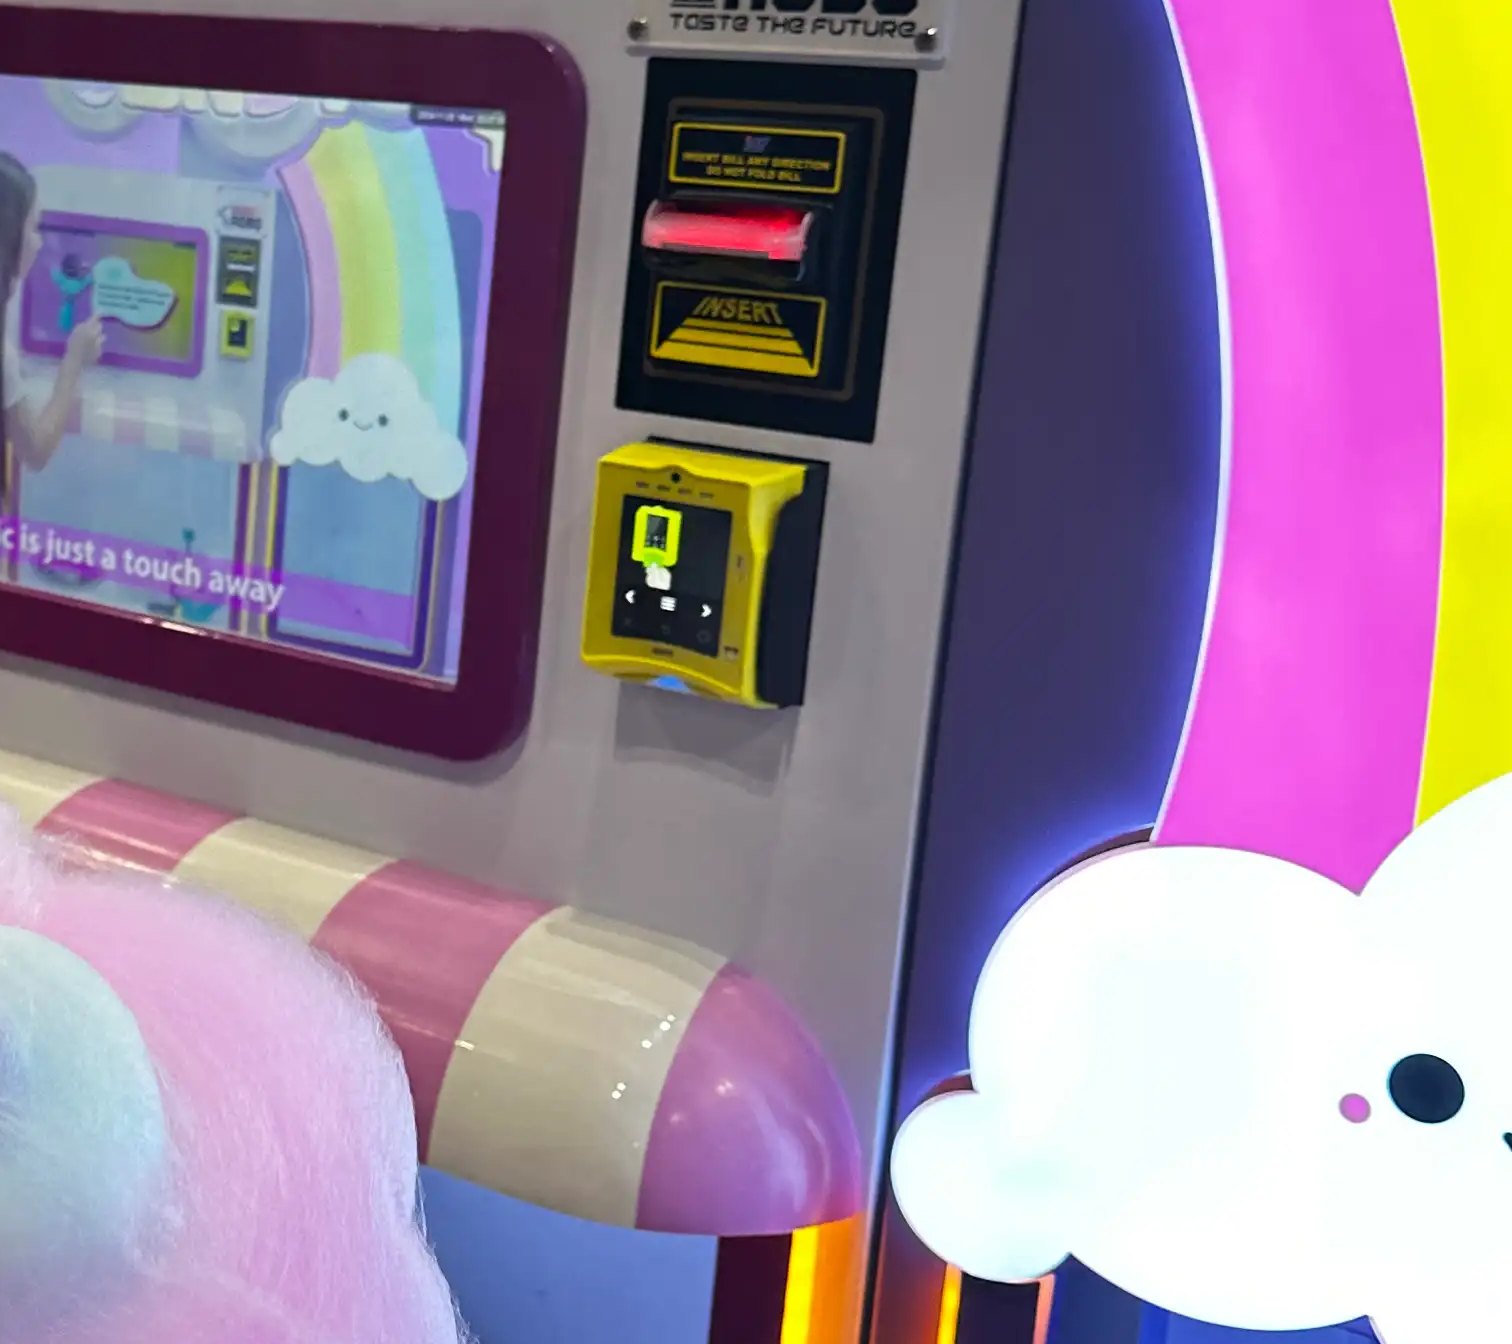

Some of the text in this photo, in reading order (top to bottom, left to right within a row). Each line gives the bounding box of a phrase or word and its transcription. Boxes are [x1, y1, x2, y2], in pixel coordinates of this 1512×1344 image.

[693, 296, 783, 325] INSERT
[20, 527, 41, 554] is
[43, 528, 96, 565] just
[101, 548, 116, 570] a
[123, 549, 201, 589] touch
[209, 569, 286, 612] away
